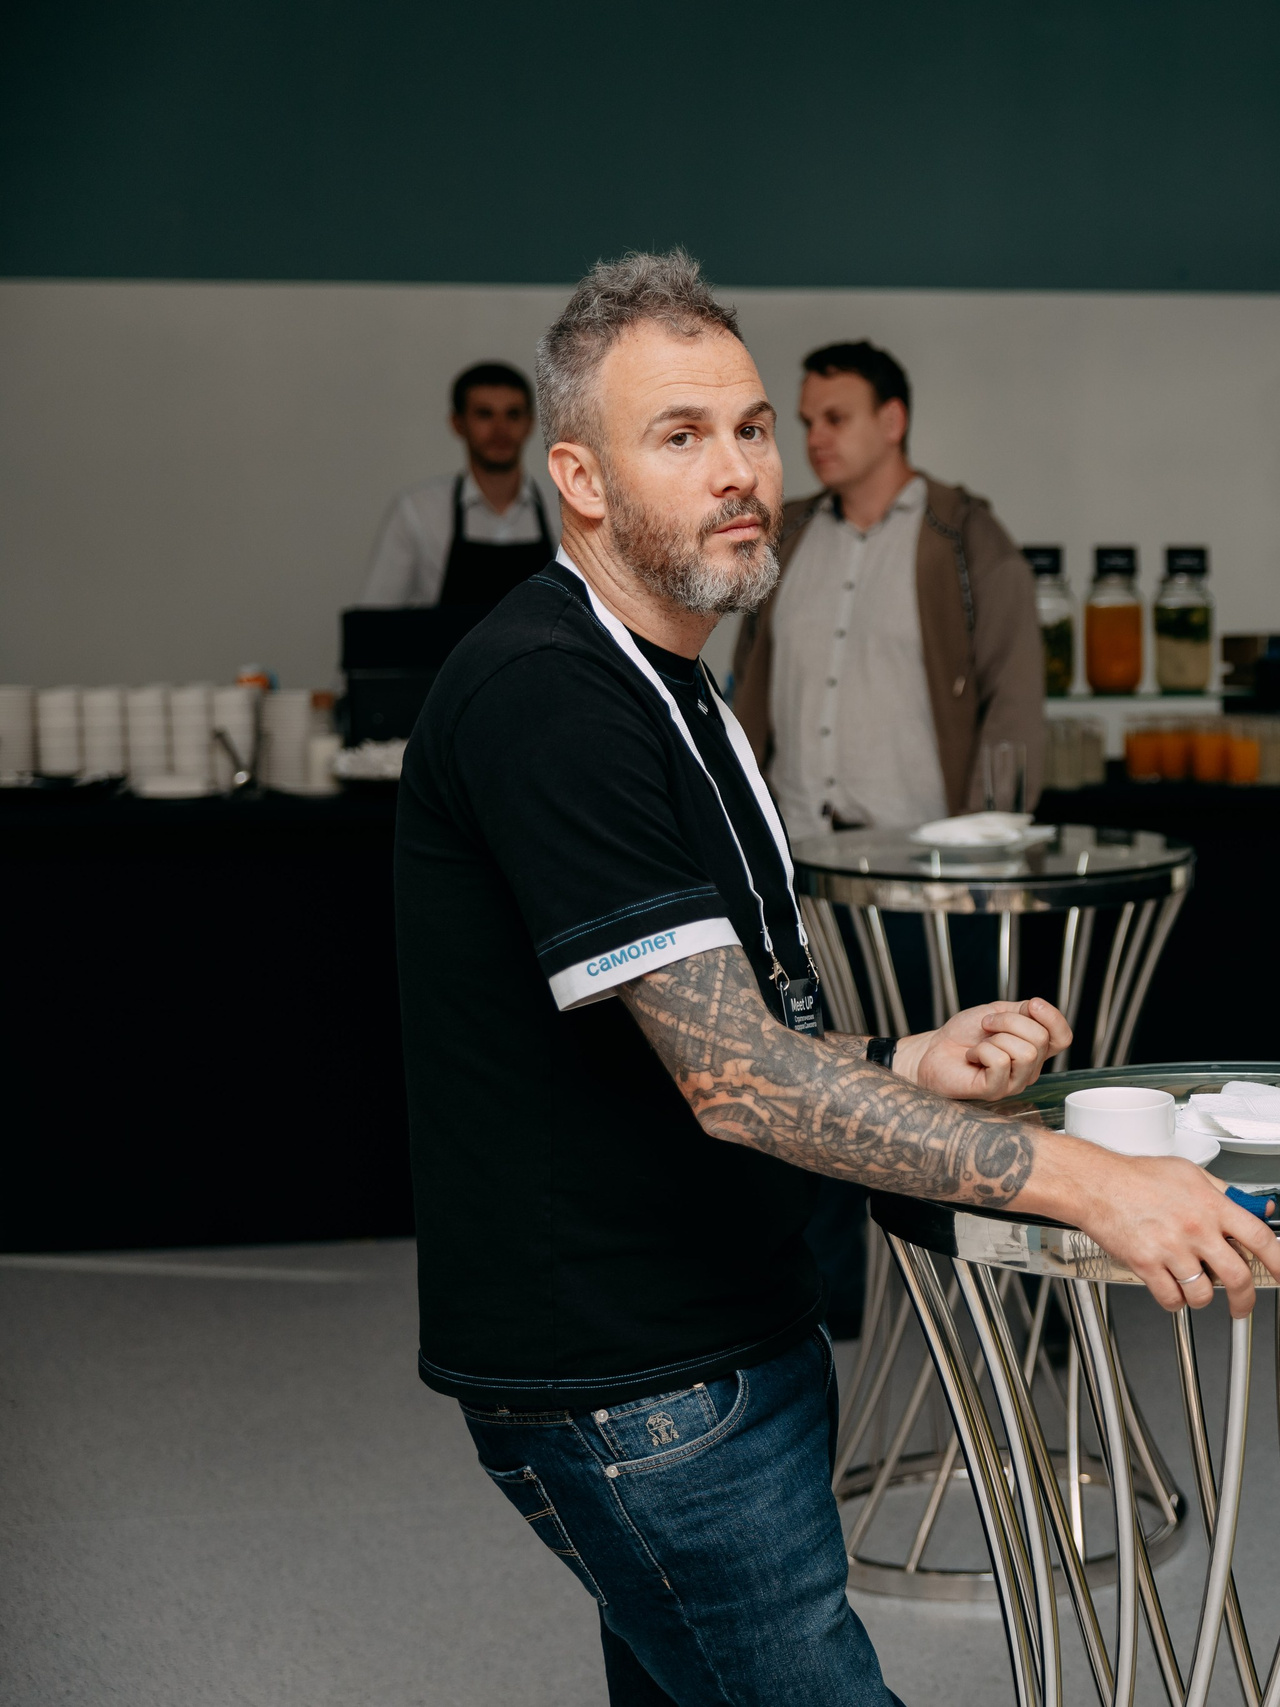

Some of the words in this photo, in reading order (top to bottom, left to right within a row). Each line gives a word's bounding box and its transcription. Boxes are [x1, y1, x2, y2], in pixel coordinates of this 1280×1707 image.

[586, 930, 677, 977] самолет
[790, 997, 806, 1012] Meet
[805, 995, 814, 1010] UP
